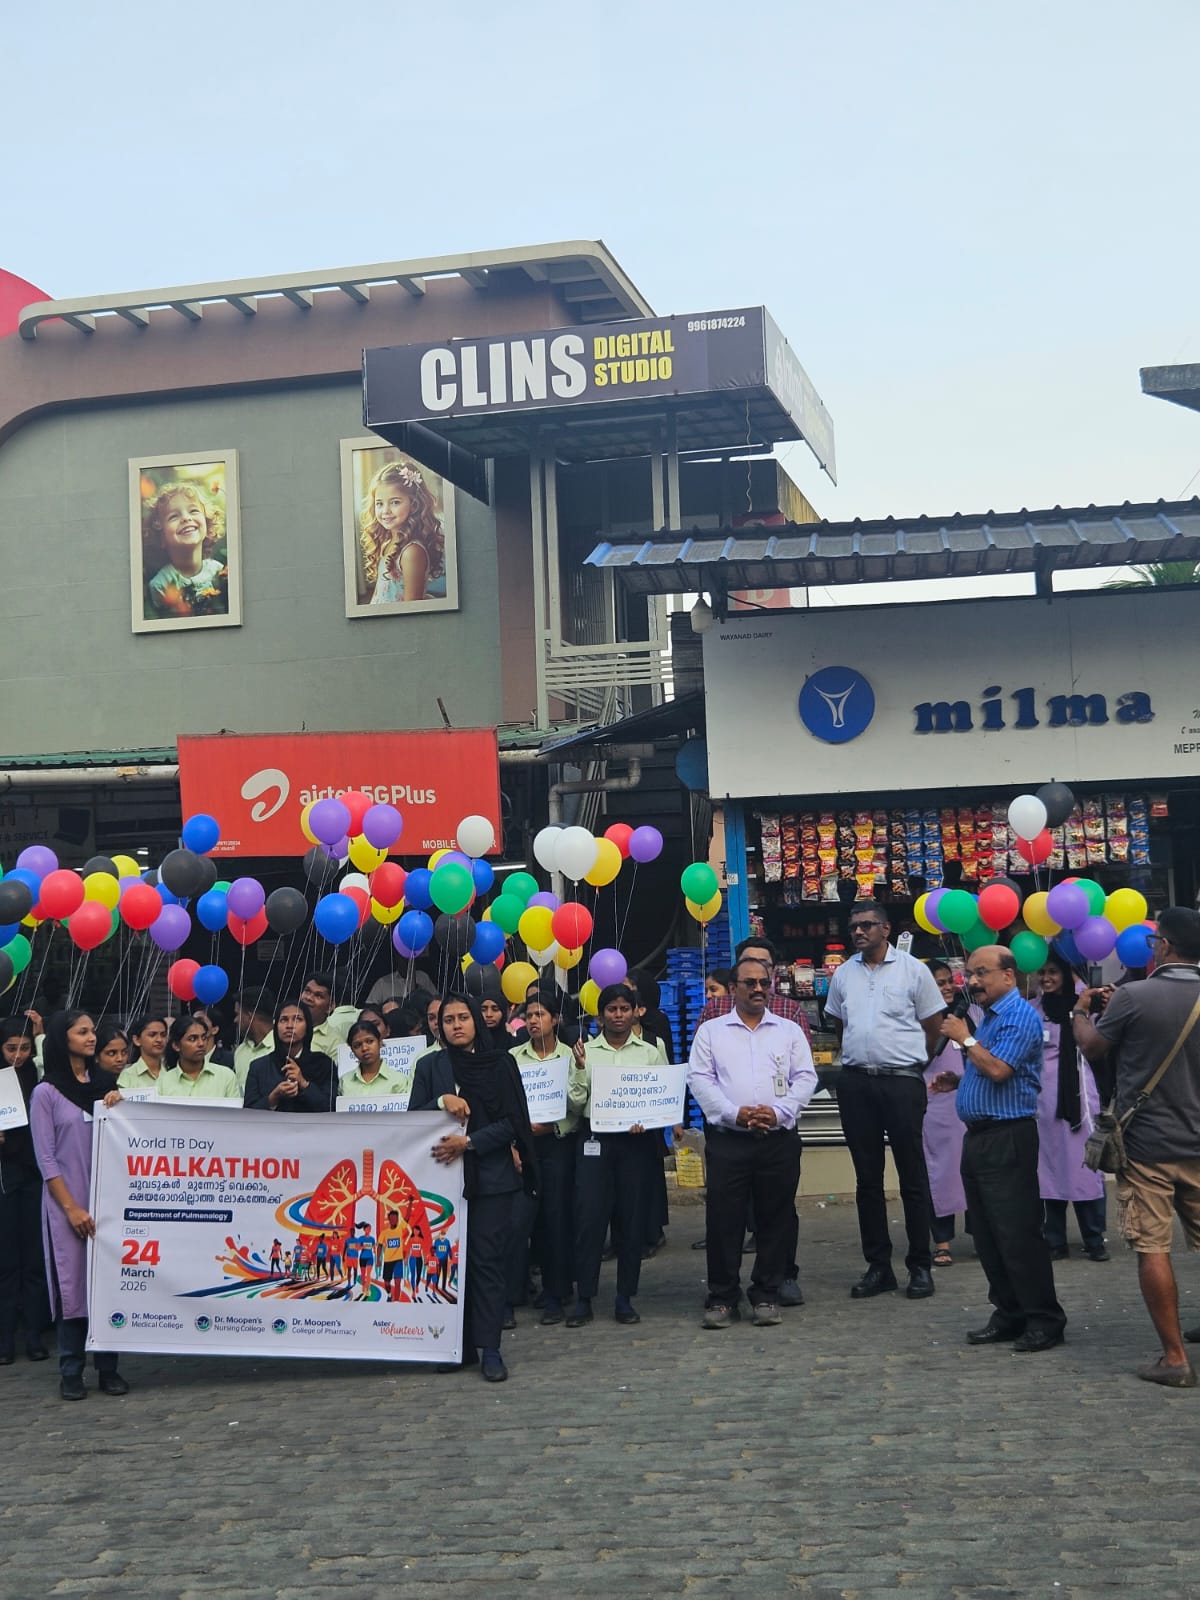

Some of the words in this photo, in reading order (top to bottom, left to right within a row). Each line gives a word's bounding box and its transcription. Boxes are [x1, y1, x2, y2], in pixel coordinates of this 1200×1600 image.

[687, 316, 746, 333] 9961874224
[593, 330, 675, 360] DIGITAL
[420, 334, 588, 412] CLINS
[594, 356, 673, 387] STUDIO
[720, 633, 752, 641] WAYANAD
[913, 685, 1156, 734] milma
[422, 839, 457, 849] MOBILE
[128, 1137, 166, 1149] World
[170, 1138, 185, 1149] TB
[189, 1138, 214, 1152] Day
[127, 1155, 300, 1179] WALKATHON
[128, 1210, 172, 1221] Department
[173, 1211, 181, 1219] of
[181, 1211, 228, 1221] Pulmonology
[125, 1227, 147, 1235] Date:
[121, 1239, 161, 1266] 24
[121, 1267, 155, 1278] March
[120, 1280, 147, 1291] 2026
[131, 1312, 142, 1321] Dr.
[143, 1312, 177, 1323] Moopen's
[214, 1315, 225, 1324] Dr.
[225, 1316, 262, 1327] Moopen's
[292, 1318, 302, 1326] Dr.
[304, 1318, 341, 1328] Moopen's
[131, 1320, 158, 1329] Medical
[158, 1321, 184, 1331] College
[214, 1324, 240, 1334] Nursing
[240, 1325, 266, 1334] College
[372, 1319, 391, 1328] Aster
[292, 1327, 316, 1336] College
[324, 1328, 357, 1337] Pharmacy
[380, 1323, 424, 1337] volunteers
